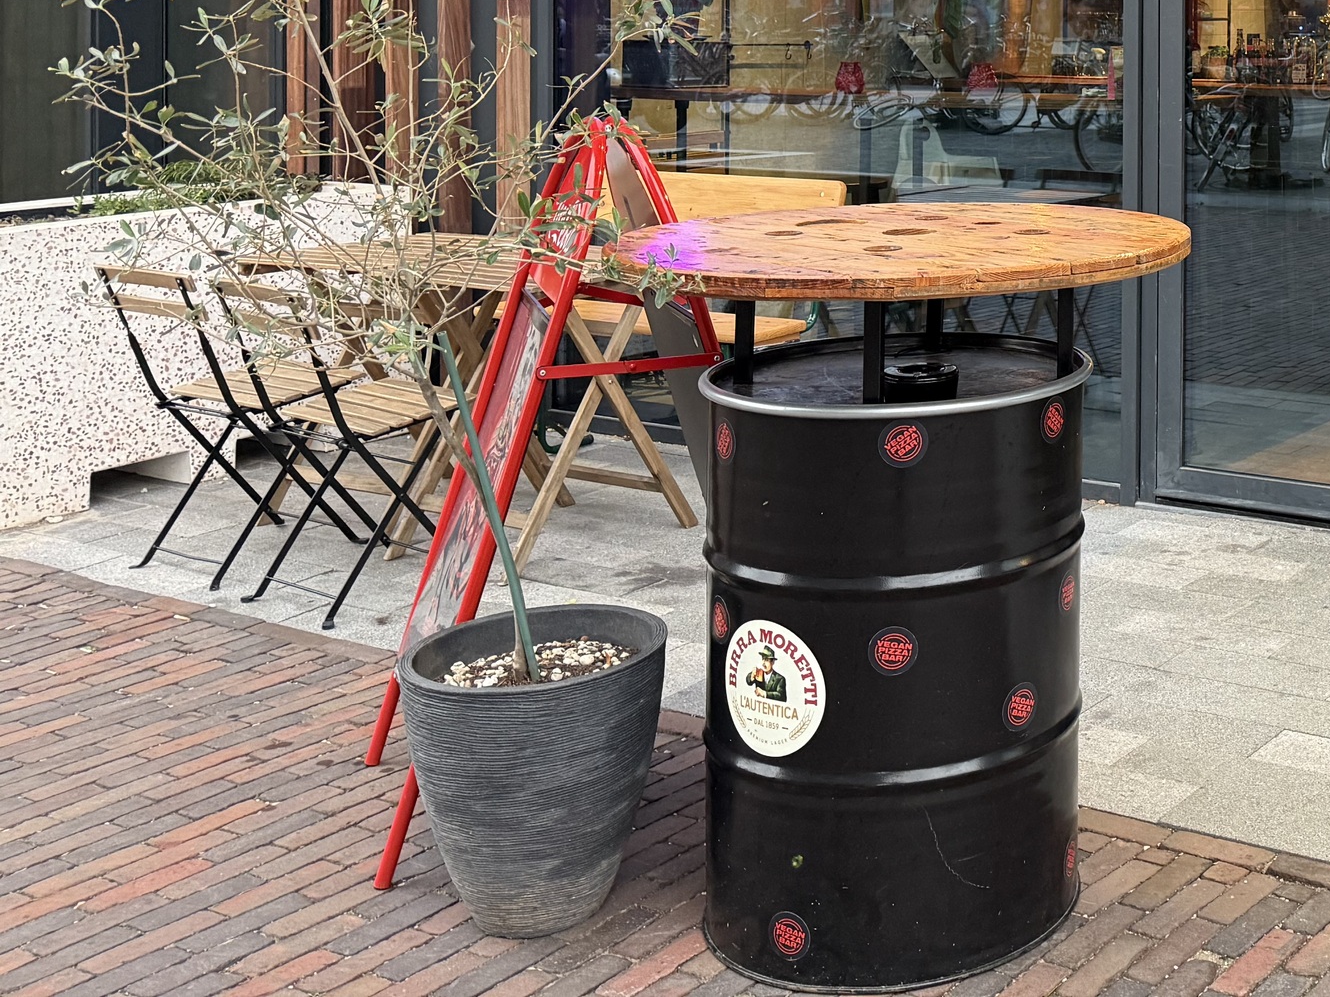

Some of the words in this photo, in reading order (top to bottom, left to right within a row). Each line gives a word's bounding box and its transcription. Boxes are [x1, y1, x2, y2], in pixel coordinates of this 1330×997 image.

[884, 426, 917, 450] VEGAN
[890, 433, 918, 454] PIZZA
[898, 440, 918, 456] BAR
[877, 640, 913, 650] VEGAN
[879, 647, 908, 656] PIZZA
[882, 654, 903, 662] BAR
[729, 630, 757, 688] BIRRA
[759, 628, 818, 706] MORETTI
[740, 695, 799, 721] L'AUTENTICA
[753, 718, 764, 728] DAL
[765, 720, 780, 730] 1859
[775, 922, 806, 939] VEGAN
[777, 929, 802, 944] PIZZA
[779, 937, 797, 949] BAR
